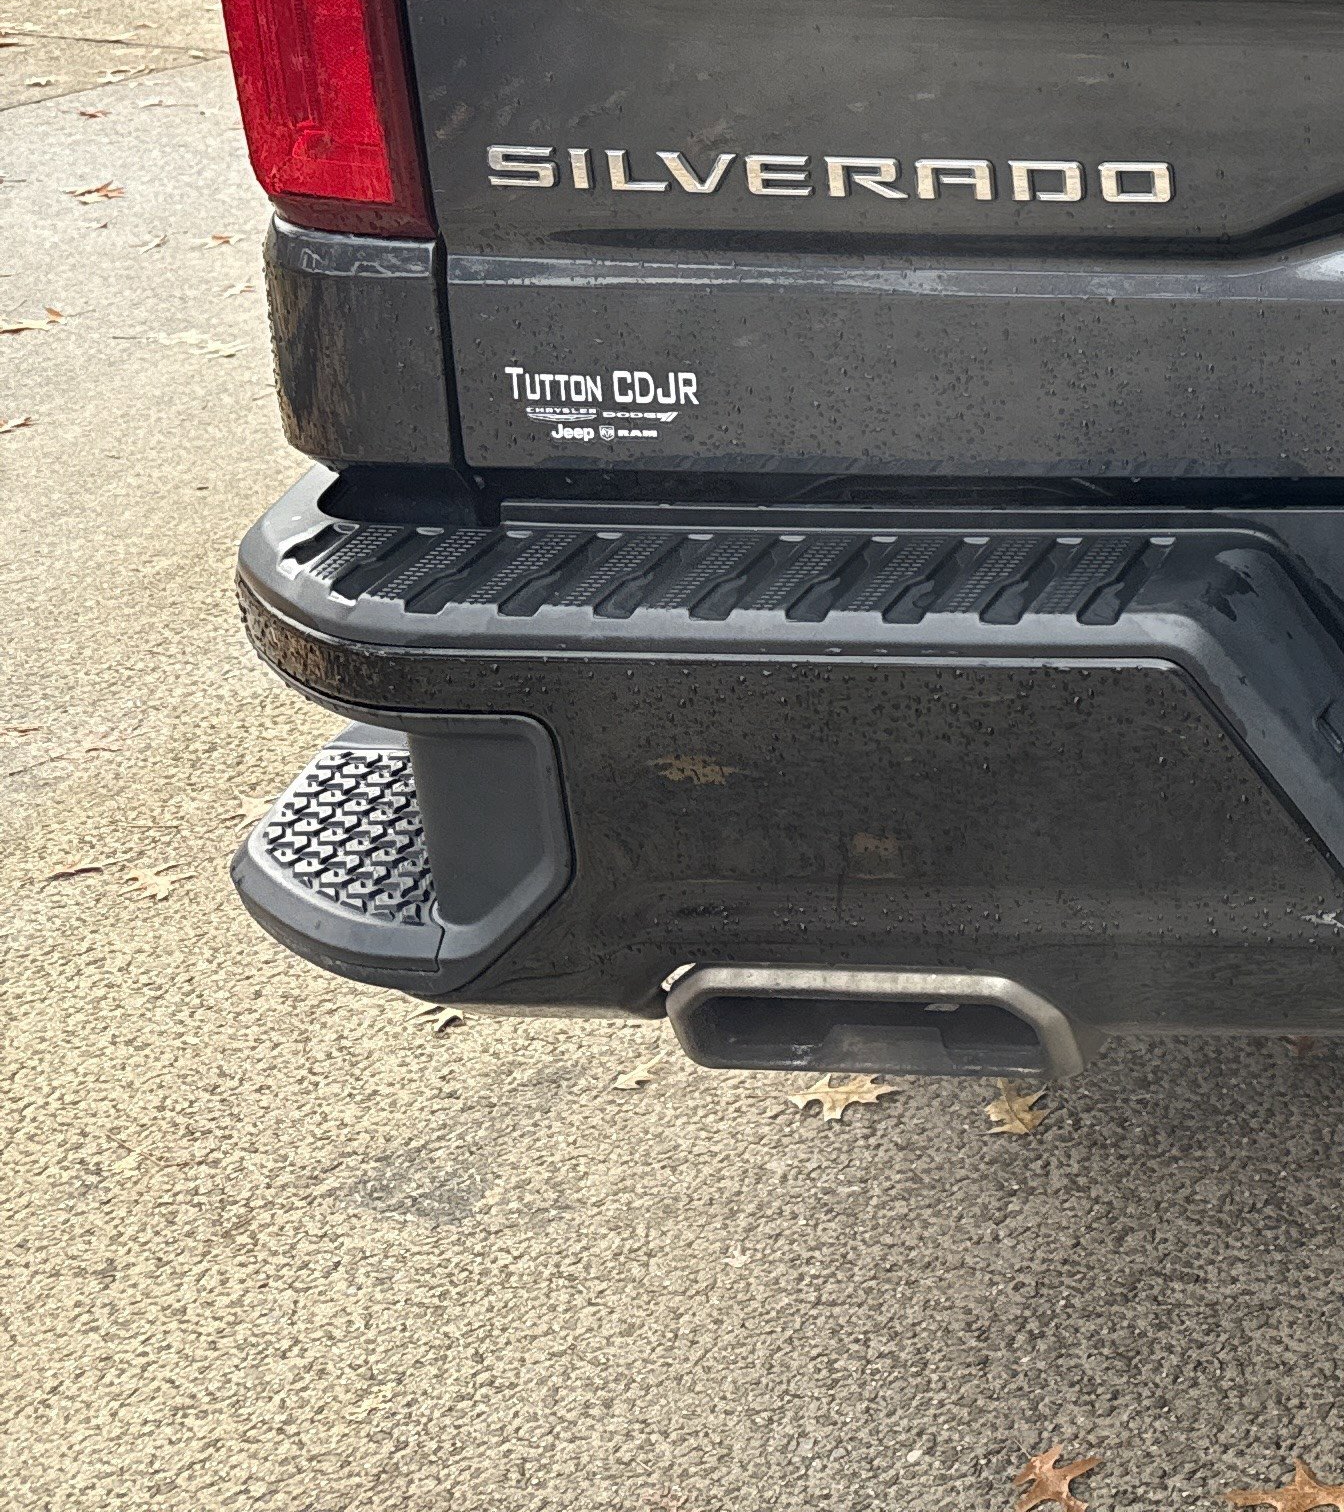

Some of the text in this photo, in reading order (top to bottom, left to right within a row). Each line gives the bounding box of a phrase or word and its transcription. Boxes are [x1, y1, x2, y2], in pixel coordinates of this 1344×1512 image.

[487, 145, 1174, 203] SILVERADO
[504, 366, 699, 405] TUTTON CDJR
[551, 423, 658, 441] Jeep RAM
